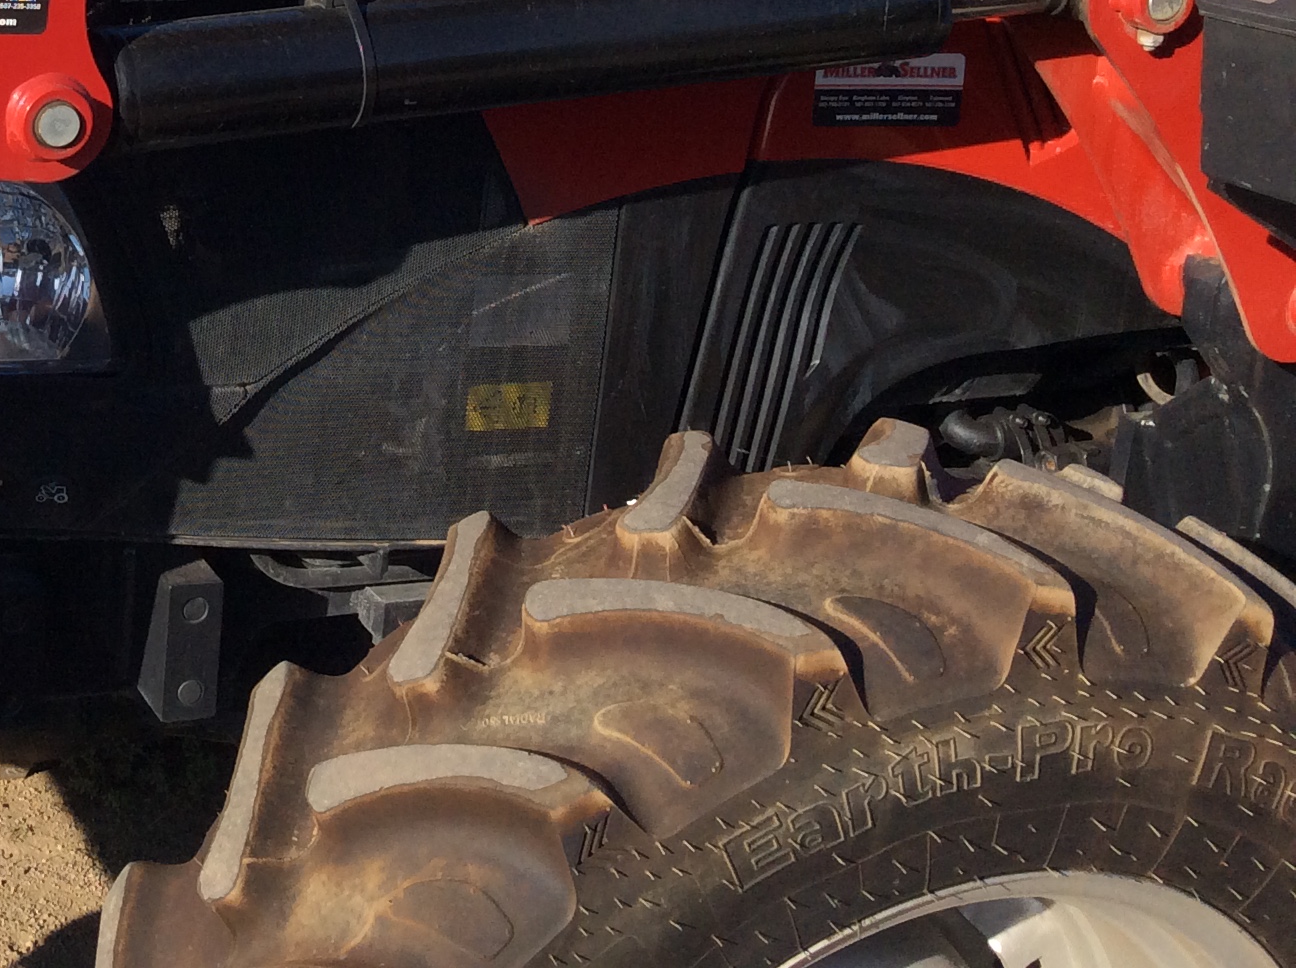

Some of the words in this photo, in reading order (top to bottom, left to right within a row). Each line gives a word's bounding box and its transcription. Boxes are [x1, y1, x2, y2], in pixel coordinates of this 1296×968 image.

[898, 62, 958, 79] SELLNER
[835, 112, 938, 122] www.millersellner.com
[502, 712, 546, 726] RADIAL
